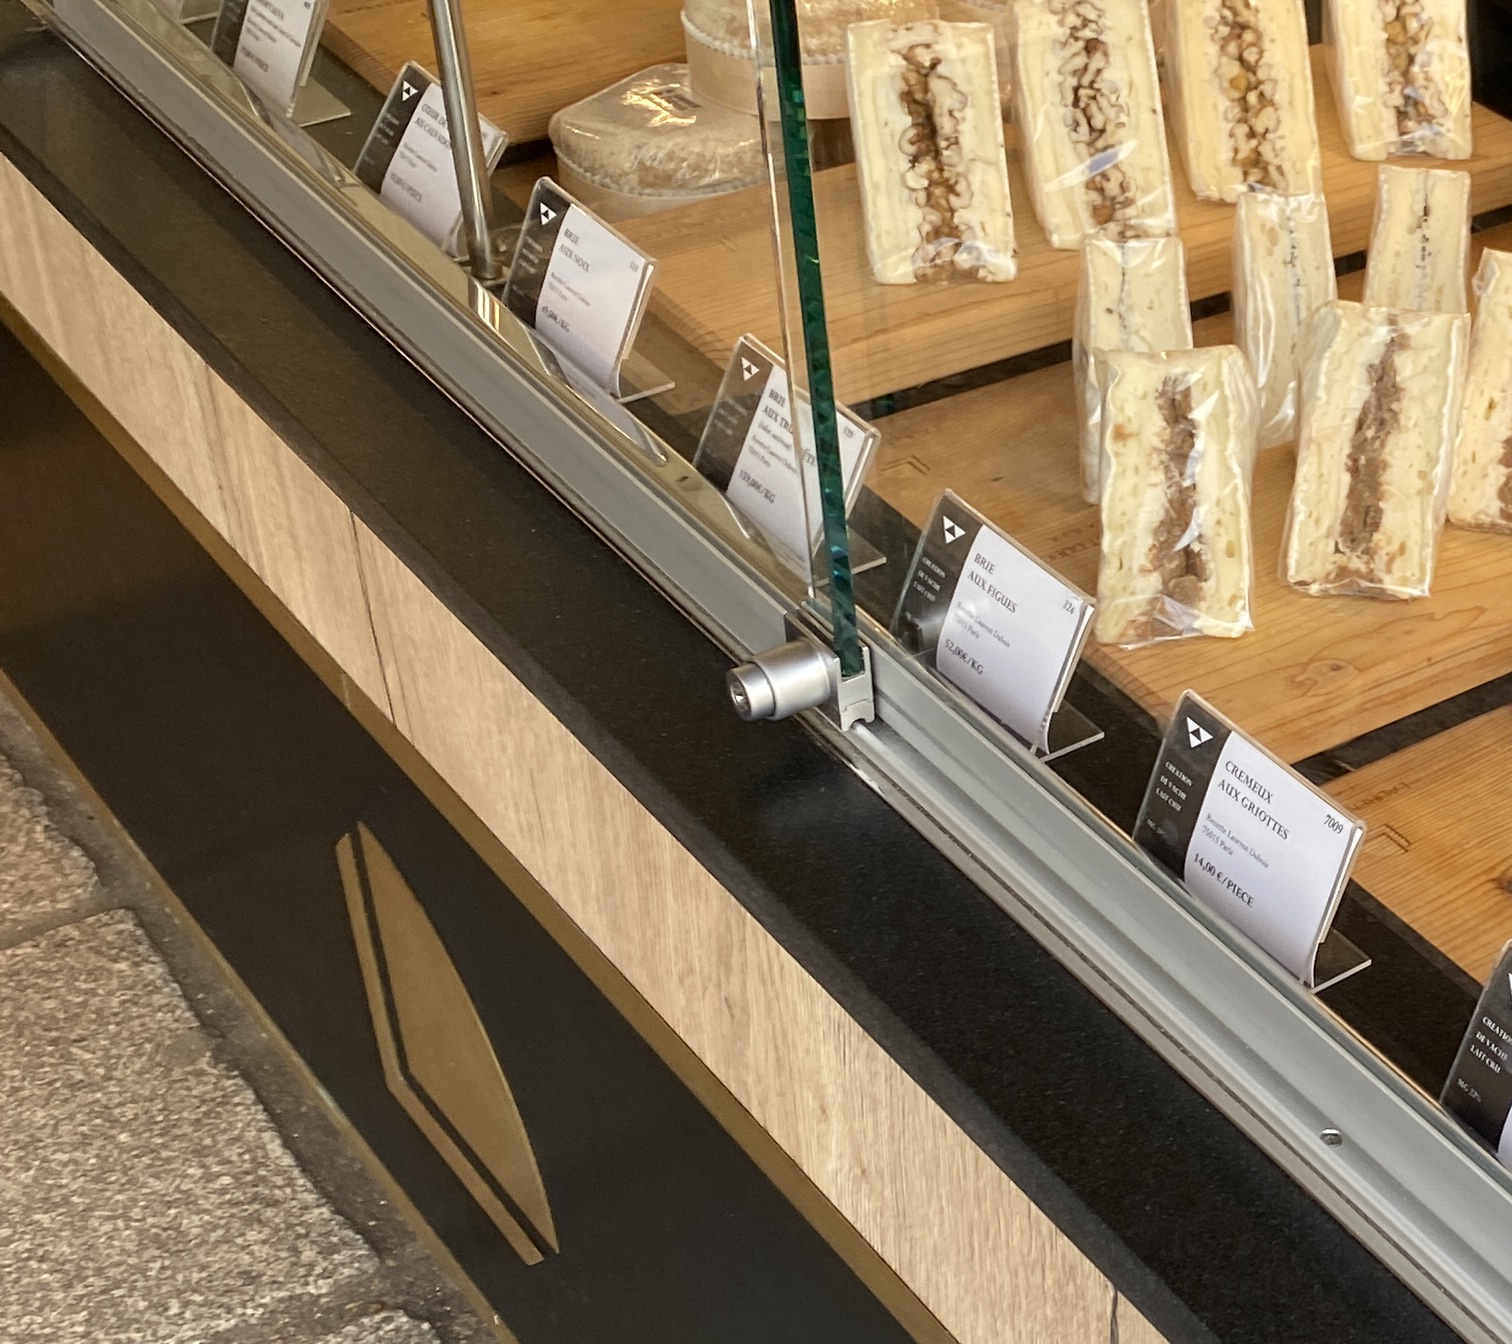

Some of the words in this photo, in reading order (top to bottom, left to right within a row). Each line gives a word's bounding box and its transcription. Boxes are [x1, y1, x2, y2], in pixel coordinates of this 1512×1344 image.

[974, 553, 994, 574] BRIE
[967, 570, 987, 591] AUX
[986, 584, 1017, 613] FIGUES
[1062, 599, 1075, 615] 324
[1224, 759, 1273, 804] CREMEUX
[1217, 778, 1240, 802] AUX
[1240, 795, 1289, 840] GRIOTTES
[1323, 813, 1343, 835] 7009
[1193, 852, 1216, 877] 14,00
